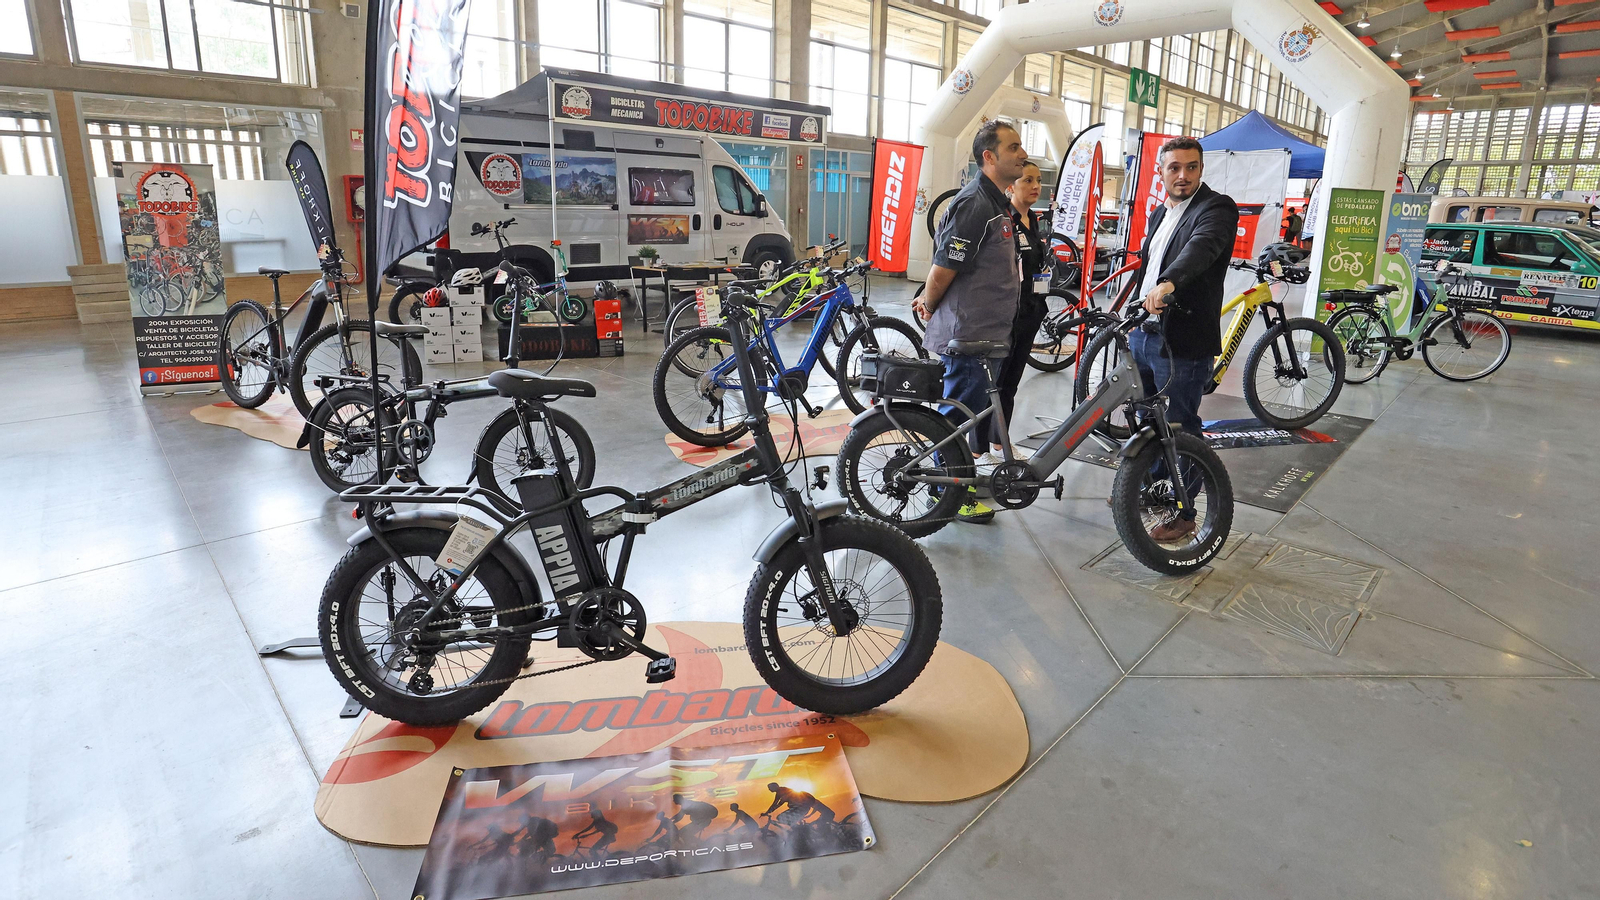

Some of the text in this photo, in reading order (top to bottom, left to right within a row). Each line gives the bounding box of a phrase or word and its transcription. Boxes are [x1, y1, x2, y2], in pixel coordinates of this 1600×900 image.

[610, 96, 645, 109] BICICLETAS
[611, 108, 644, 119] MECANICA
[655, 98, 754, 136] TODOBIKE
[138, 200, 199, 212] TODOBIKE
[1066, 171, 1086, 232] CLUB JEREZ
[1580, 276, 1597, 289] 10
[696, 287, 709, 327] REBAJAS
[1501, 294, 1550, 306] romeral
[170, 318, 213, 326] EXPOSICIÓN
[1224, 308, 1253, 364] ombardo
[521, 338, 592, 352] ODOBIKE
[161, 368, 214, 383] ¡Síguenos!
[1064, 407, 1104, 449] Lombardo
[672, 466, 737, 501] Lombardo
[1263, 467, 1303, 499] KALKHOFF
[534, 524, 581, 593] APPIA
[1211, 535, 1222, 552] CST
[819, 570, 836, 604] SIGNUM
[760, 570, 784, 672] CST BFT 20x4.0
[329, 601, 376, 699] CST BFT 20x4.0
[474, 685, 812, 740] Lombard
[710, 716, 837, 736] Bicycles since 1952
[464, 745, 825, 810] WST
